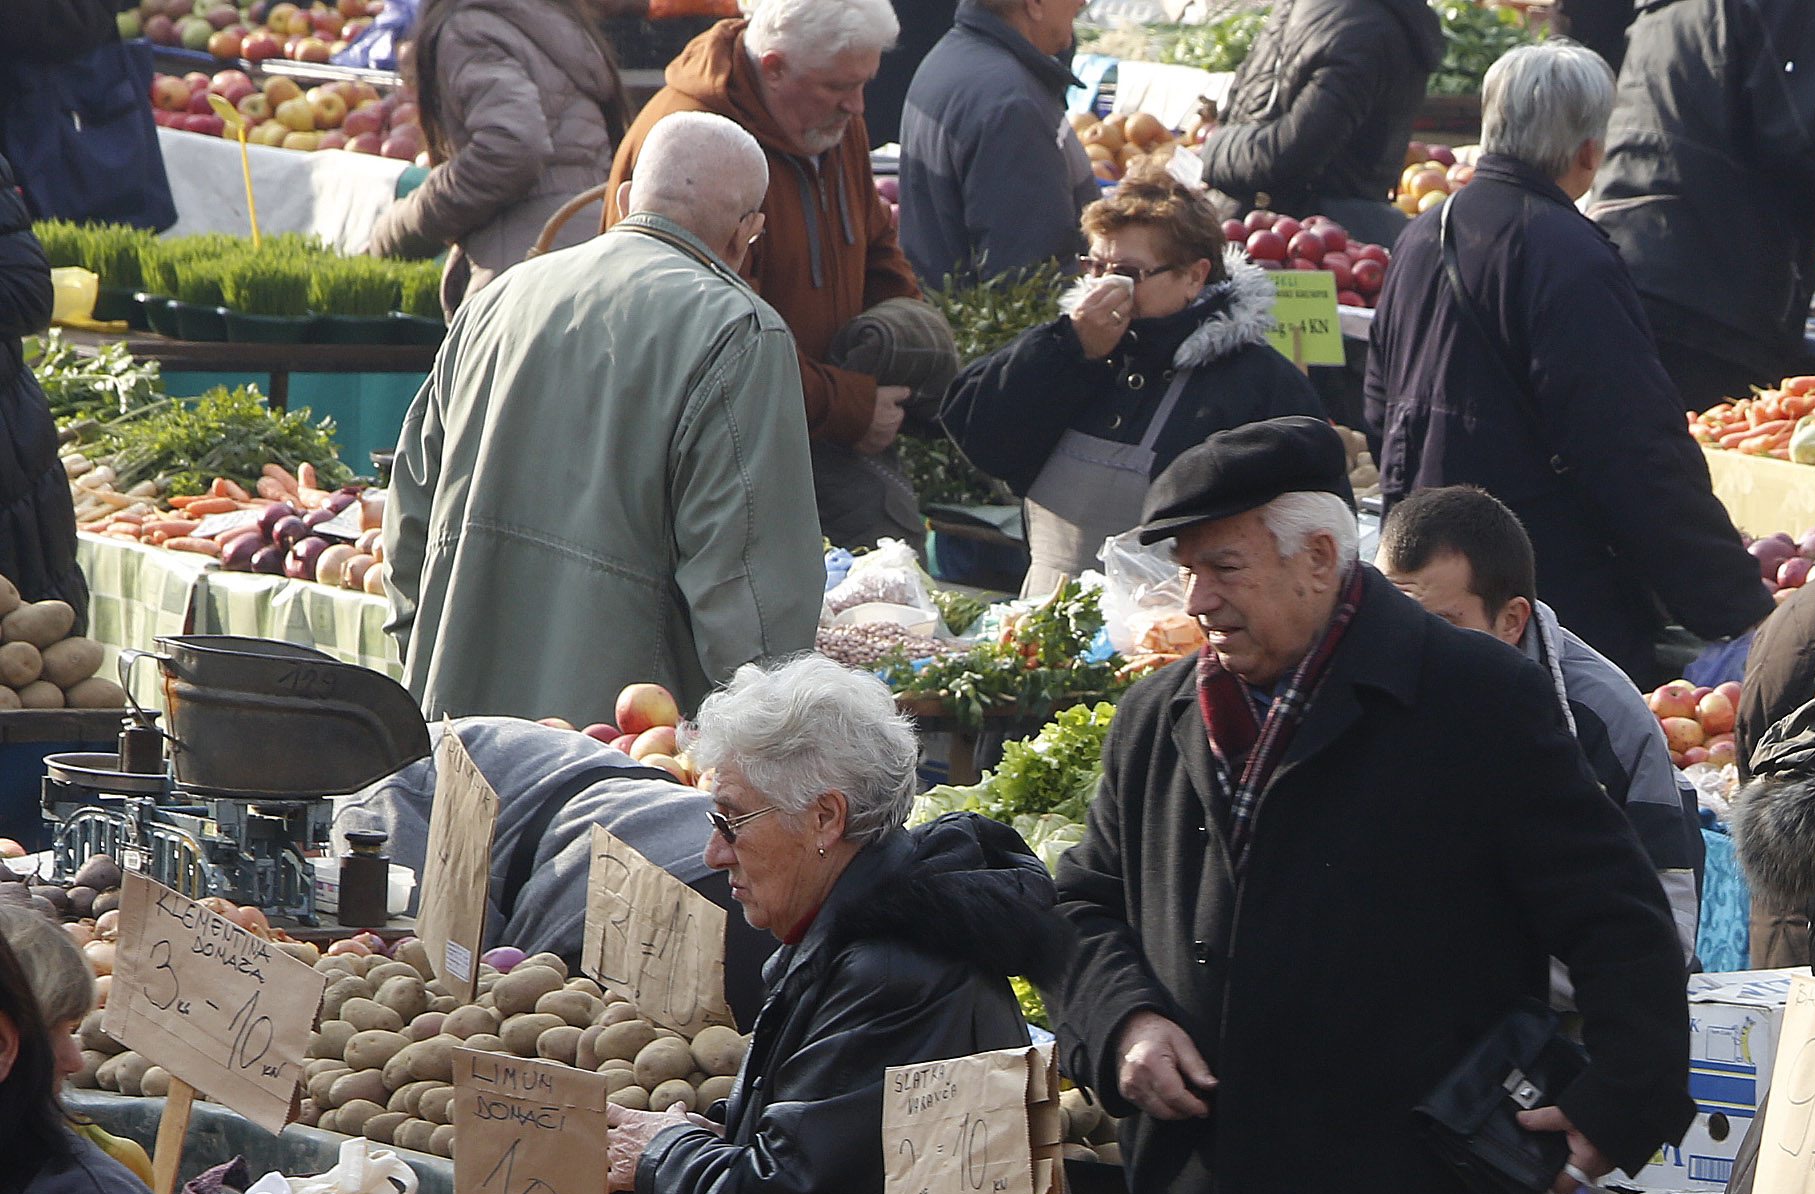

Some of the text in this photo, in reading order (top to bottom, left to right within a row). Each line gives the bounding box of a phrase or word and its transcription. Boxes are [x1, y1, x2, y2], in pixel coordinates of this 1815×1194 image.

[156, 893, 272, 963] KLEMENTINA
[143, 940, 179, 1011] 3
[228, 990, 273, 1069] 10
[471, 1056, 553, 1093] LIMUN
[894, 1064, 945, 1093] SLATKA
[952, 1113, 988, 1192] 10
